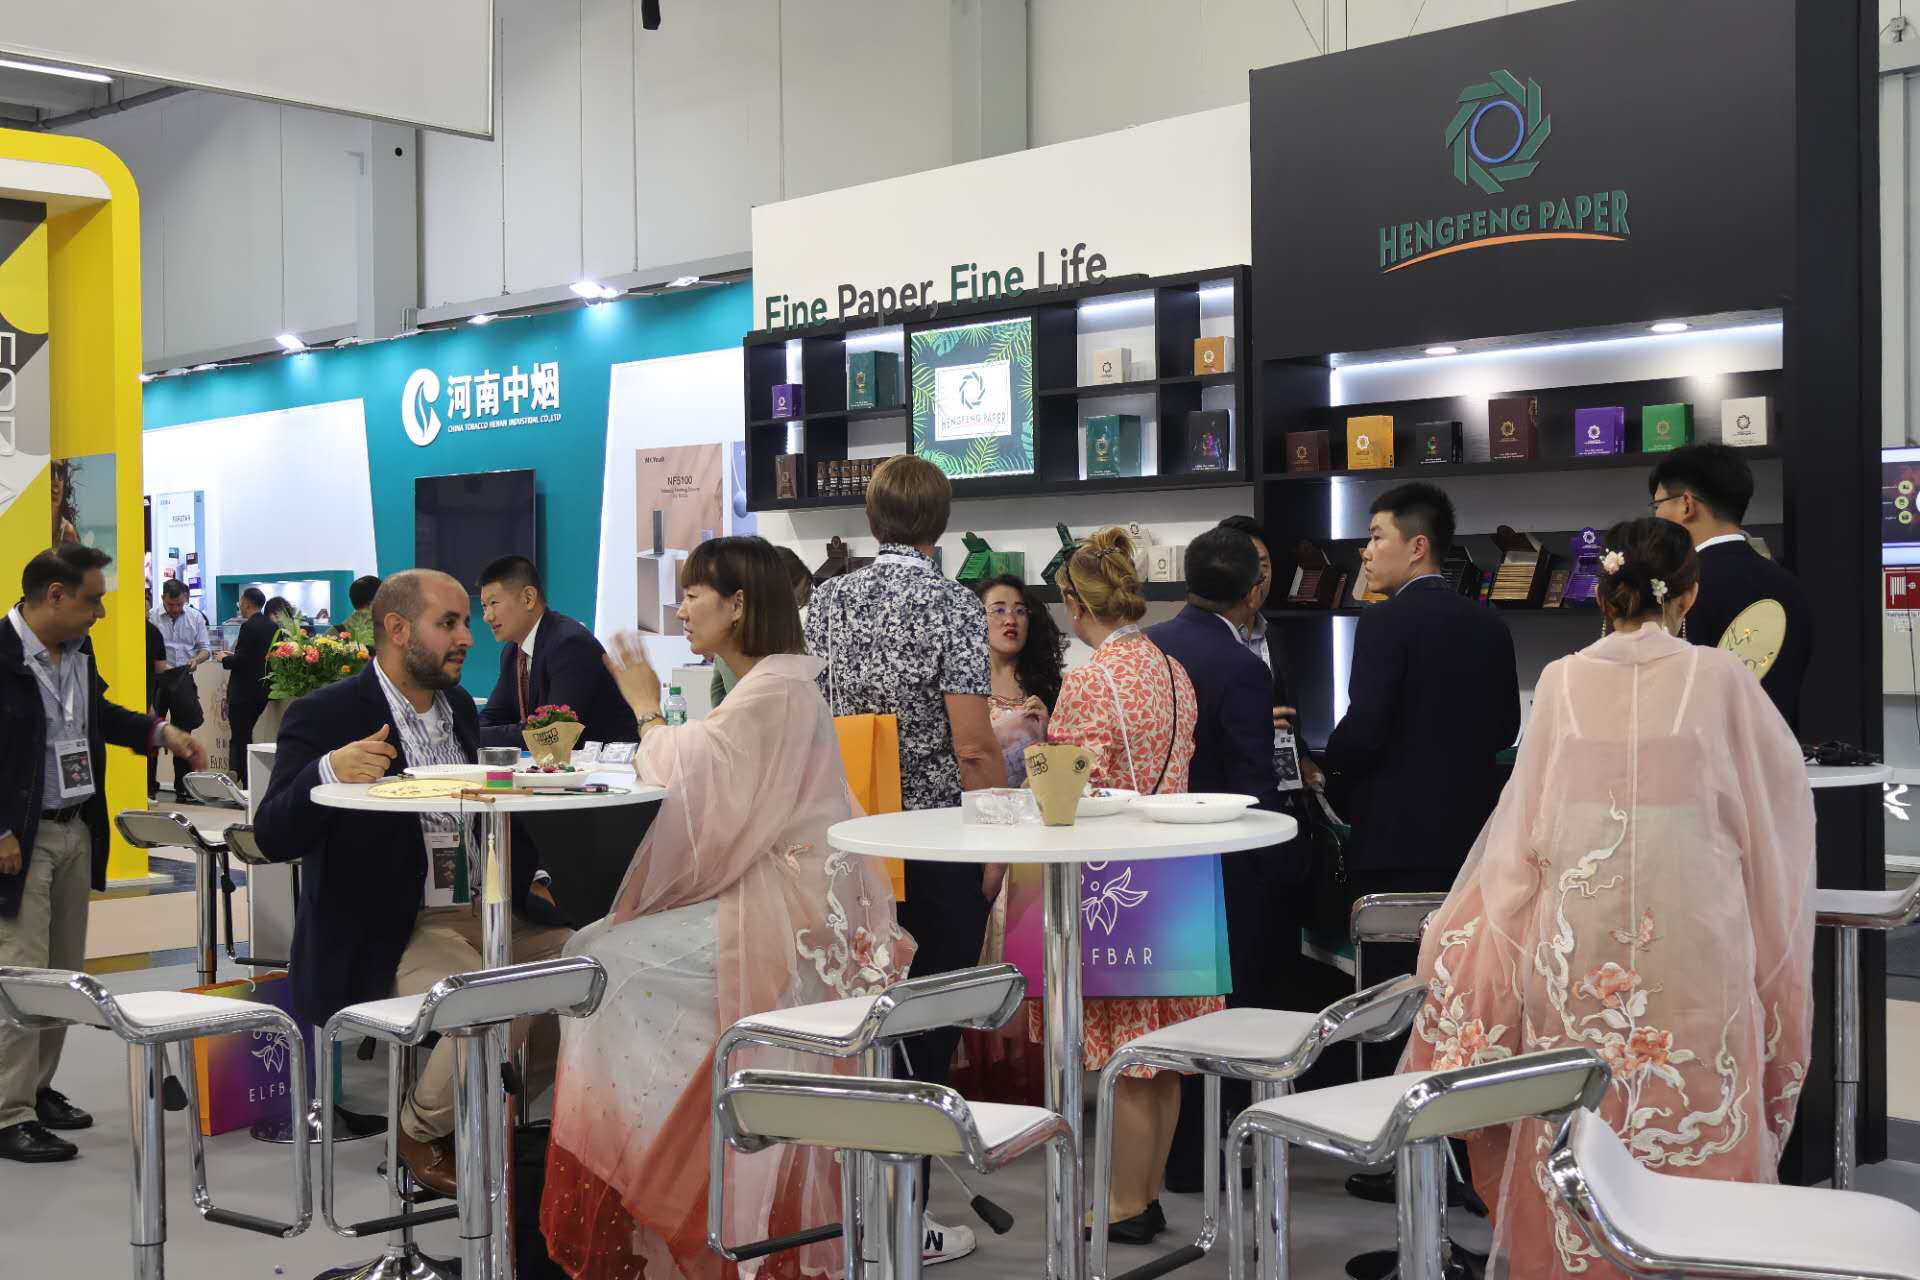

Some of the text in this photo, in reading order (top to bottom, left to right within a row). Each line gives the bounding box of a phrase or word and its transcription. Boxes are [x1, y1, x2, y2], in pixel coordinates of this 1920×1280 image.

[1379, 189, 1630, 267] HENGFENG PAPER
[765, 242, 1107, 334] Fine Paper, Fine Life
[447, 361, 560, 420] 河南中烟
[447, 424, 464, 433] CHINA
[465, 422, 489, 431] TOBACCO
[508, 416, 539, 426] INDUSTRIAL
[983, 412, 1006, 425] PAPER
[1082, 947, 1153, 965] FBAR
[249, 1081, 292, 1103] ELFB
[925, 1230, 944, 1252] N
